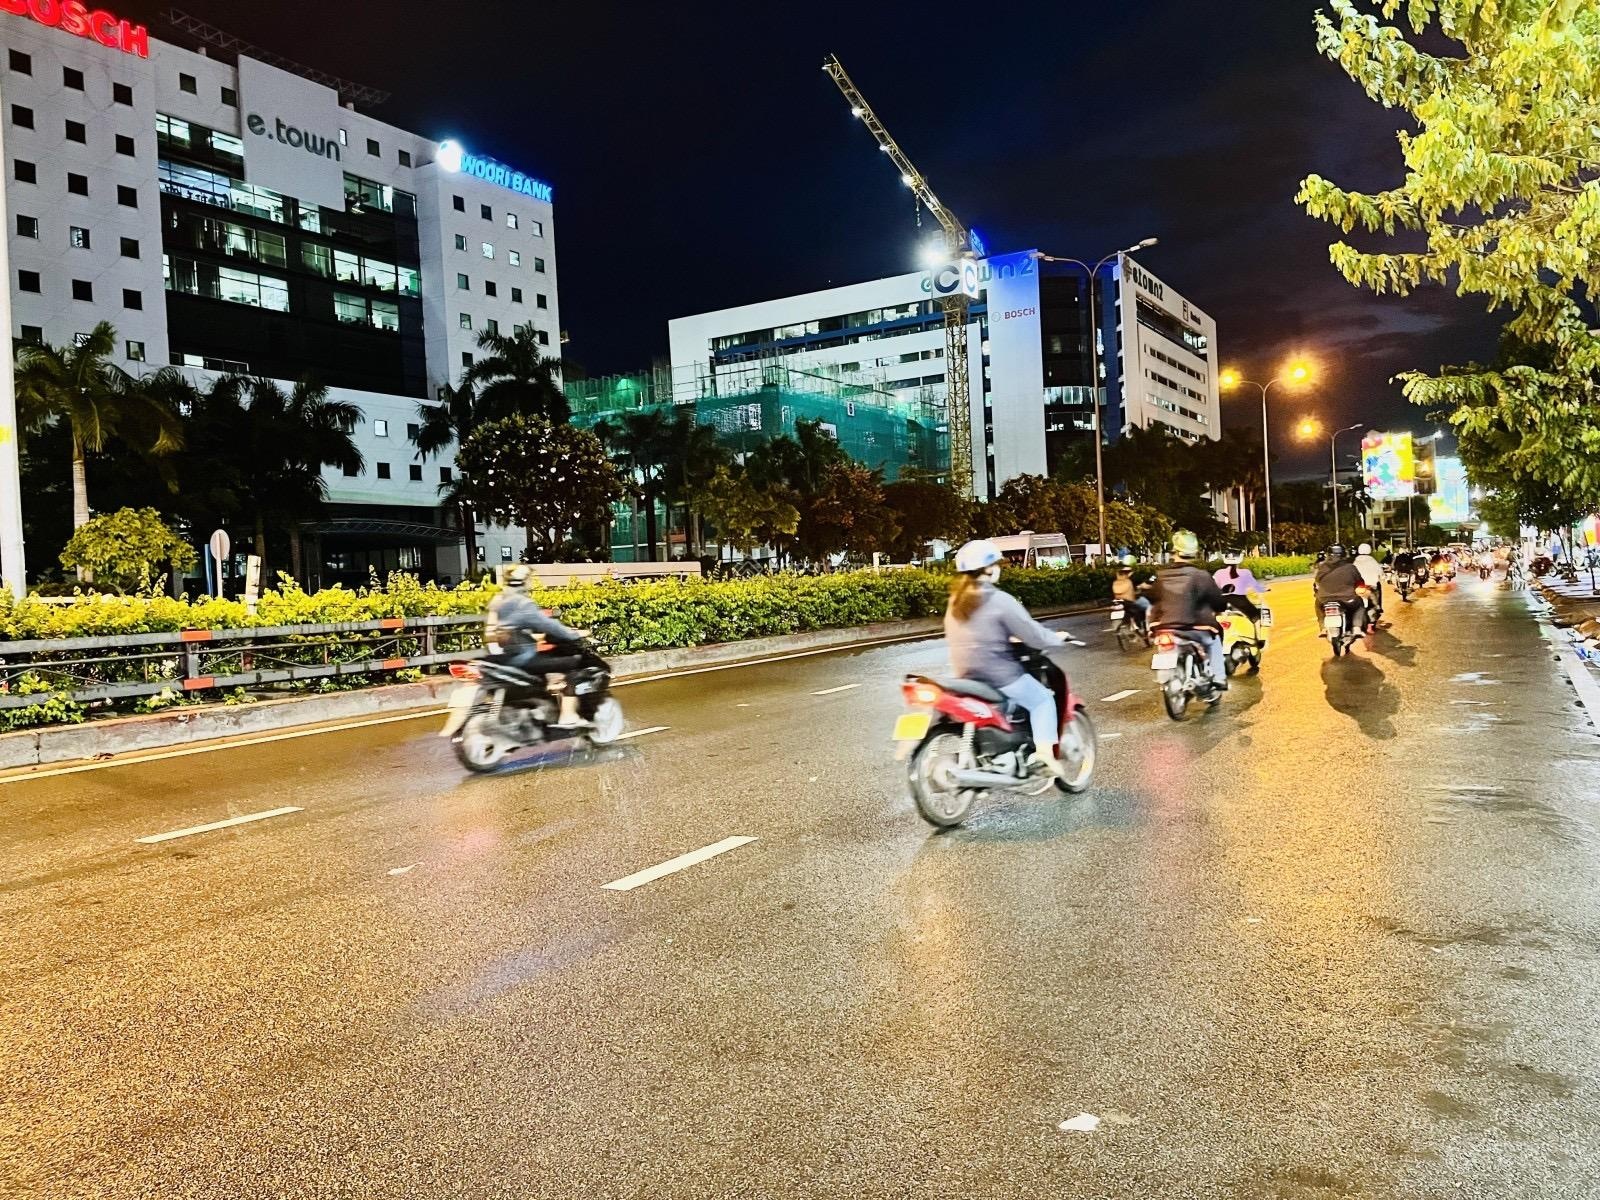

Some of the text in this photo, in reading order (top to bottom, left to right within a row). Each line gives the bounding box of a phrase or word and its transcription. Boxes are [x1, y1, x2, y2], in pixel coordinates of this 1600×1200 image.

[247, 114, 340, 162] e.town
[461, 154, 553, 203] WOORI BANK
[1004, 307, 1036, 320] BOSCH
